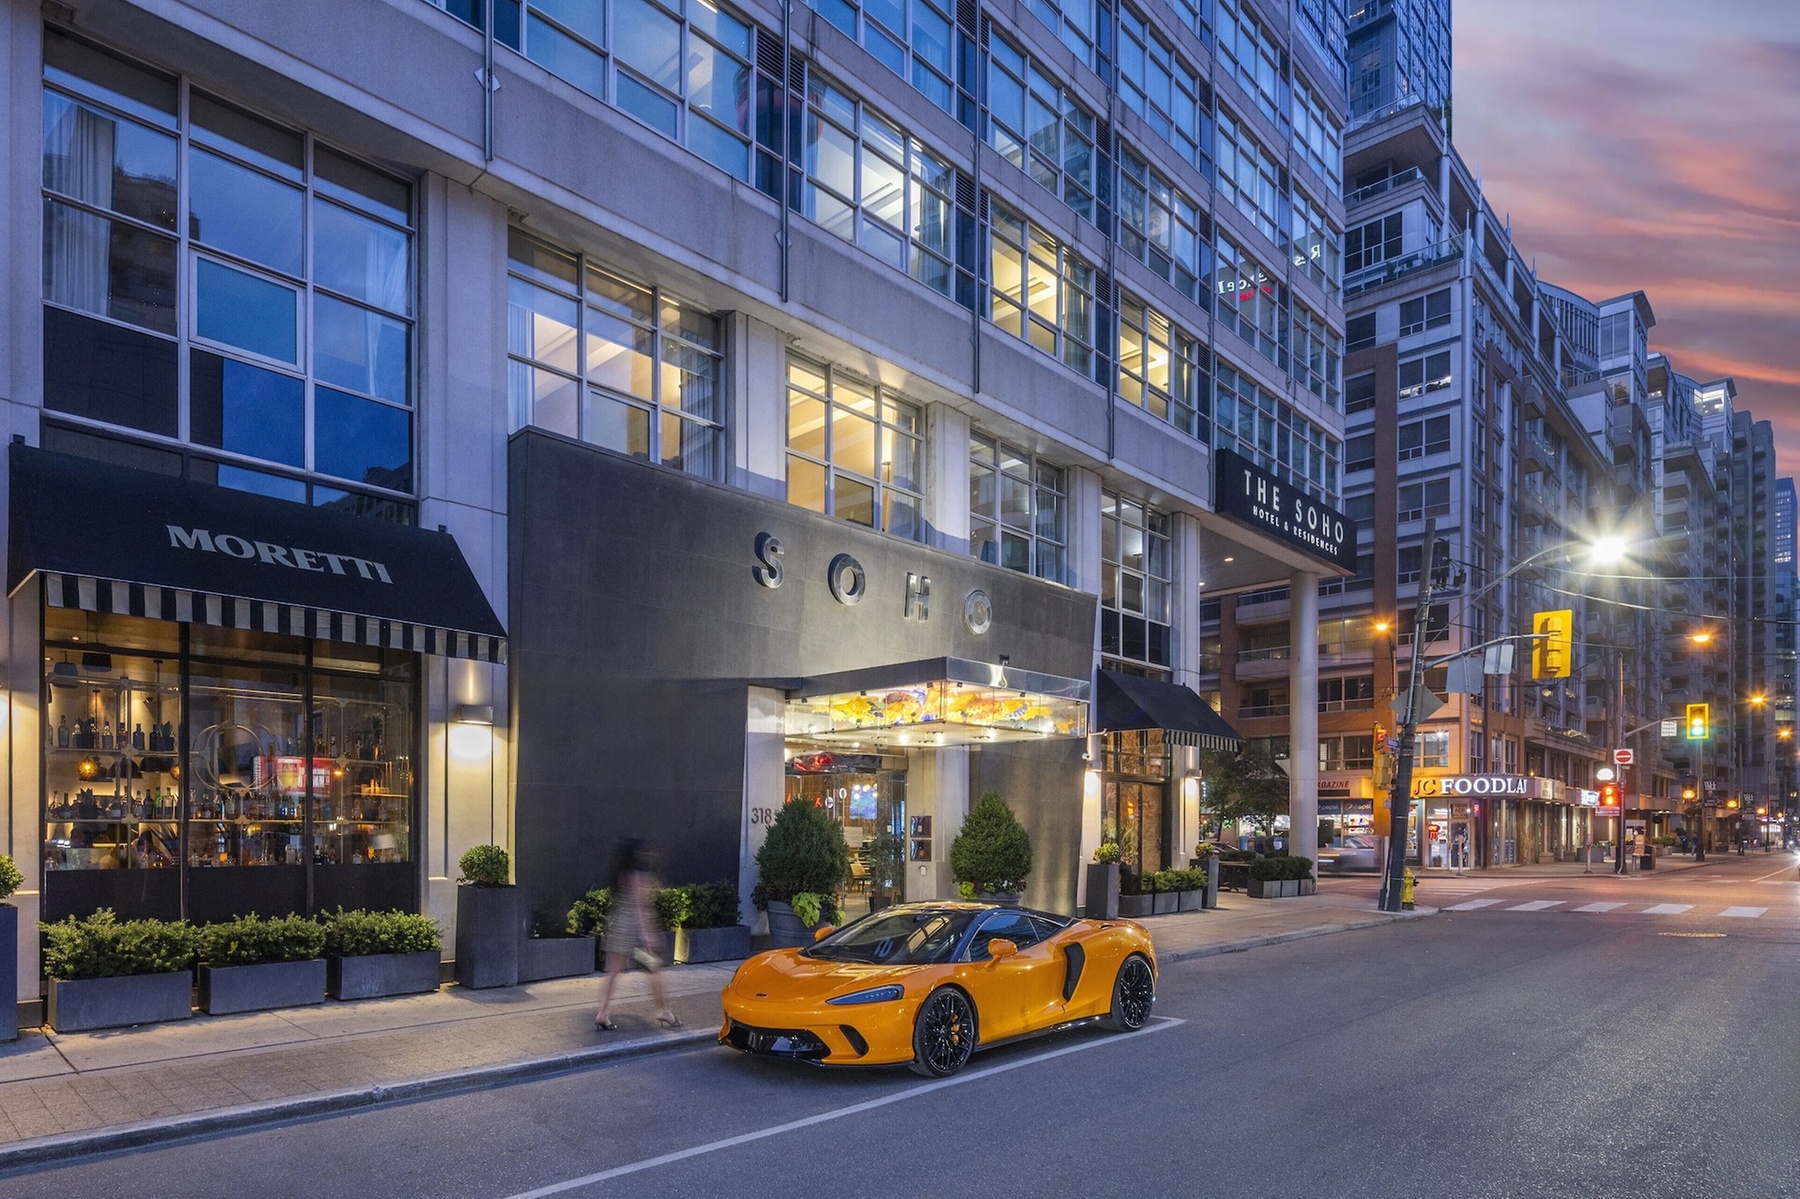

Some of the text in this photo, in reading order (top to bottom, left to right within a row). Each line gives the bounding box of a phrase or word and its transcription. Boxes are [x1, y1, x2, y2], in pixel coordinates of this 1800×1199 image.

[1244, 469, 1344, 544] THE SOHO
[1252, 505, 1338, 556] HOTEL & RESIDENCES
[165, 524, 394, 584] MORETTI
[754, 534, 992, 635] SOHO
[1413, 779, 1437, 796] JC
[751, 807, 772, 824] 318
